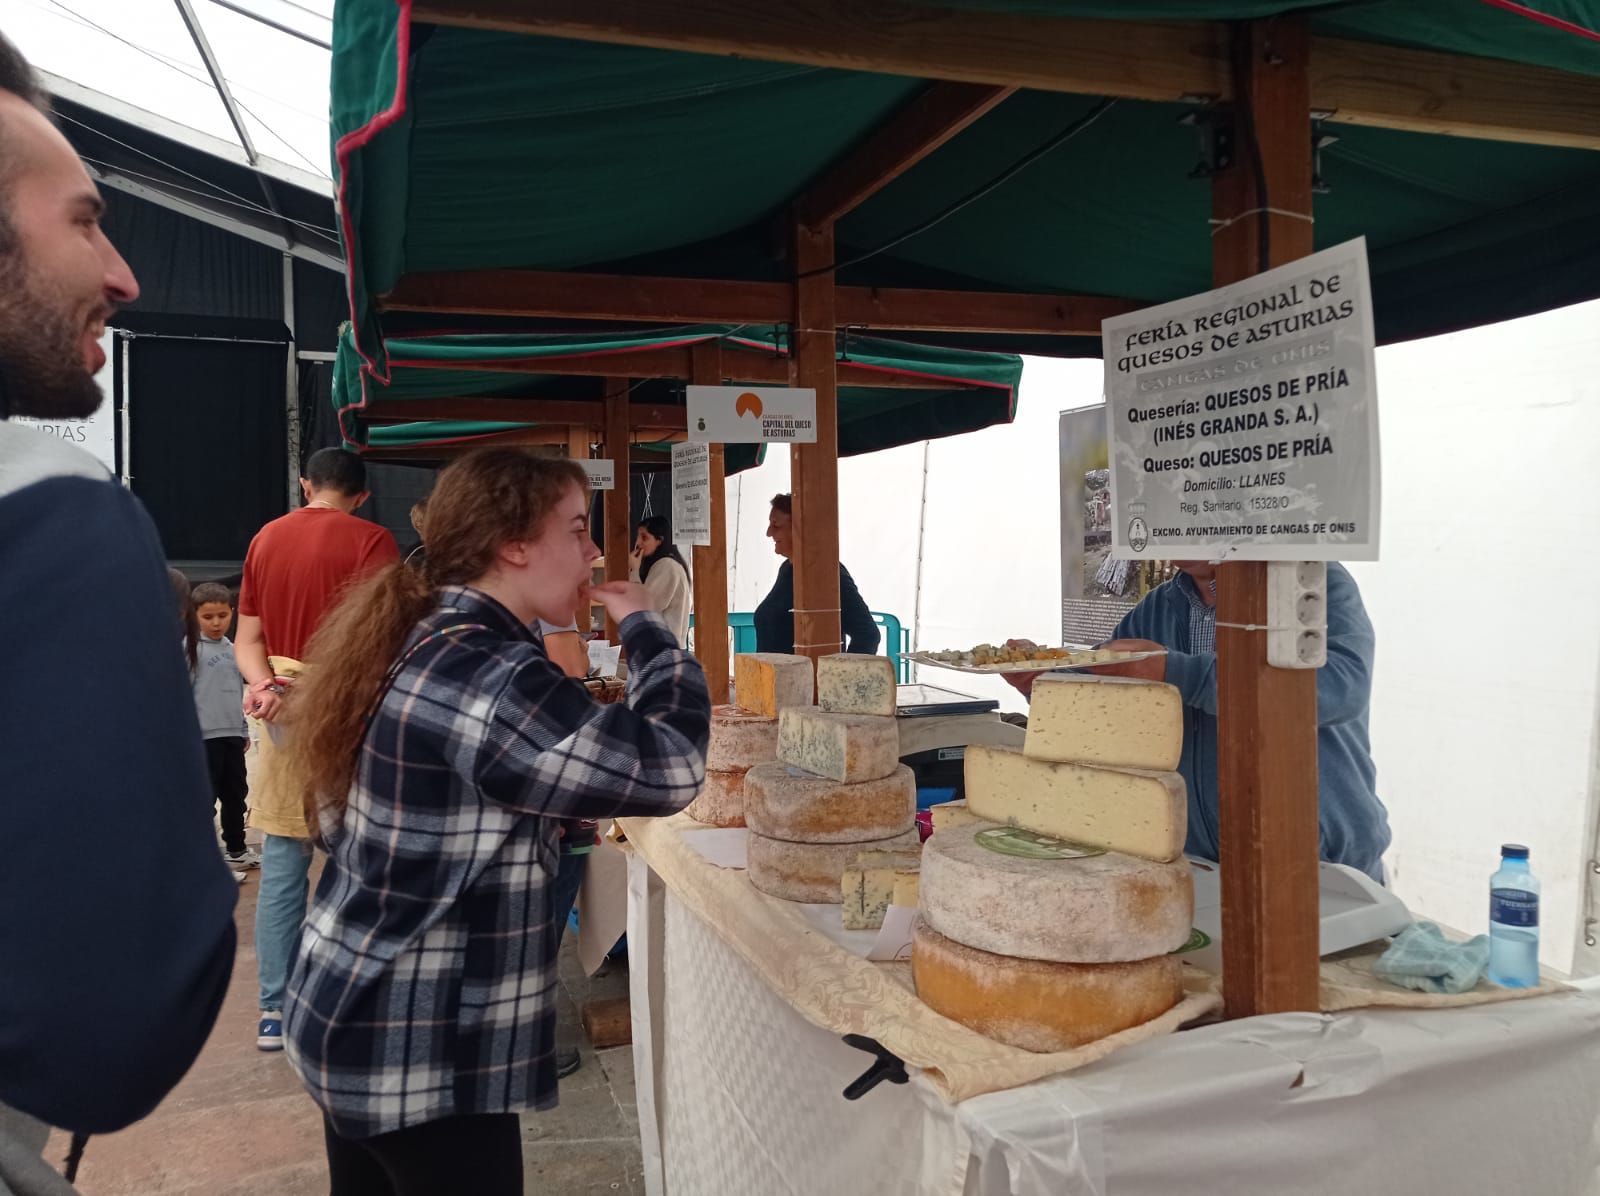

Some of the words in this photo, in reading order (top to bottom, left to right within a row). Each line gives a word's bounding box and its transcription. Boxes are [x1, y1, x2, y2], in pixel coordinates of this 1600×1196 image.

[1125, 319, 1188, 352] FERÍA
[1193, 285, 1303, 334] REGIONAL
[1309, 275, 1341, 299] DE
[1117, 340, 1204, 374] QUESOS
[1211, 332, 1240, 352] DE
[1246, 299, 1354, 344] ASTURIAS
[1127, 398, 1200, 424] Quesería:
[1204, 384, 1272, 412] QUESOS
[1277, 378, 1301, 399] DE
[1305, 368, 1349, 394] PRÍA
[763, 420, 784, 429] CAPITAL
[785, 420, 794, 429] DEL
[794, 420, 812, 429] QUESO
[1153, 420, 1195, 447] (INÉS
[1200, 411, 1269, 437] GRANDA
[1274, 408, 1290, 426] S.
[1294, 402, 1320, 426] A.)
[1143, 455, 1195, 473] Queso:
[1199, 444, 1262, 468] QUESOS
[1267, 441, 1288, 461] DE
[1292, 433, 1334, 458] PRÍA
[1183, 478, 1236, 493] Domicilio:
[1239, 471, 1286, 489] LLANES
[1180, 501, 1200, 516] Reg.
[1152, 526, 1184, 537] EXCMO.
[1185, 525, 1254, 537] AYUNTAMIENTO
[1256, 525, 1268, 535] DE
[1270, 523, 1310, 535] CANGAS
[1313, 523, 1326, 534] DE
[1330, 522, 1356, 533] ONIS
